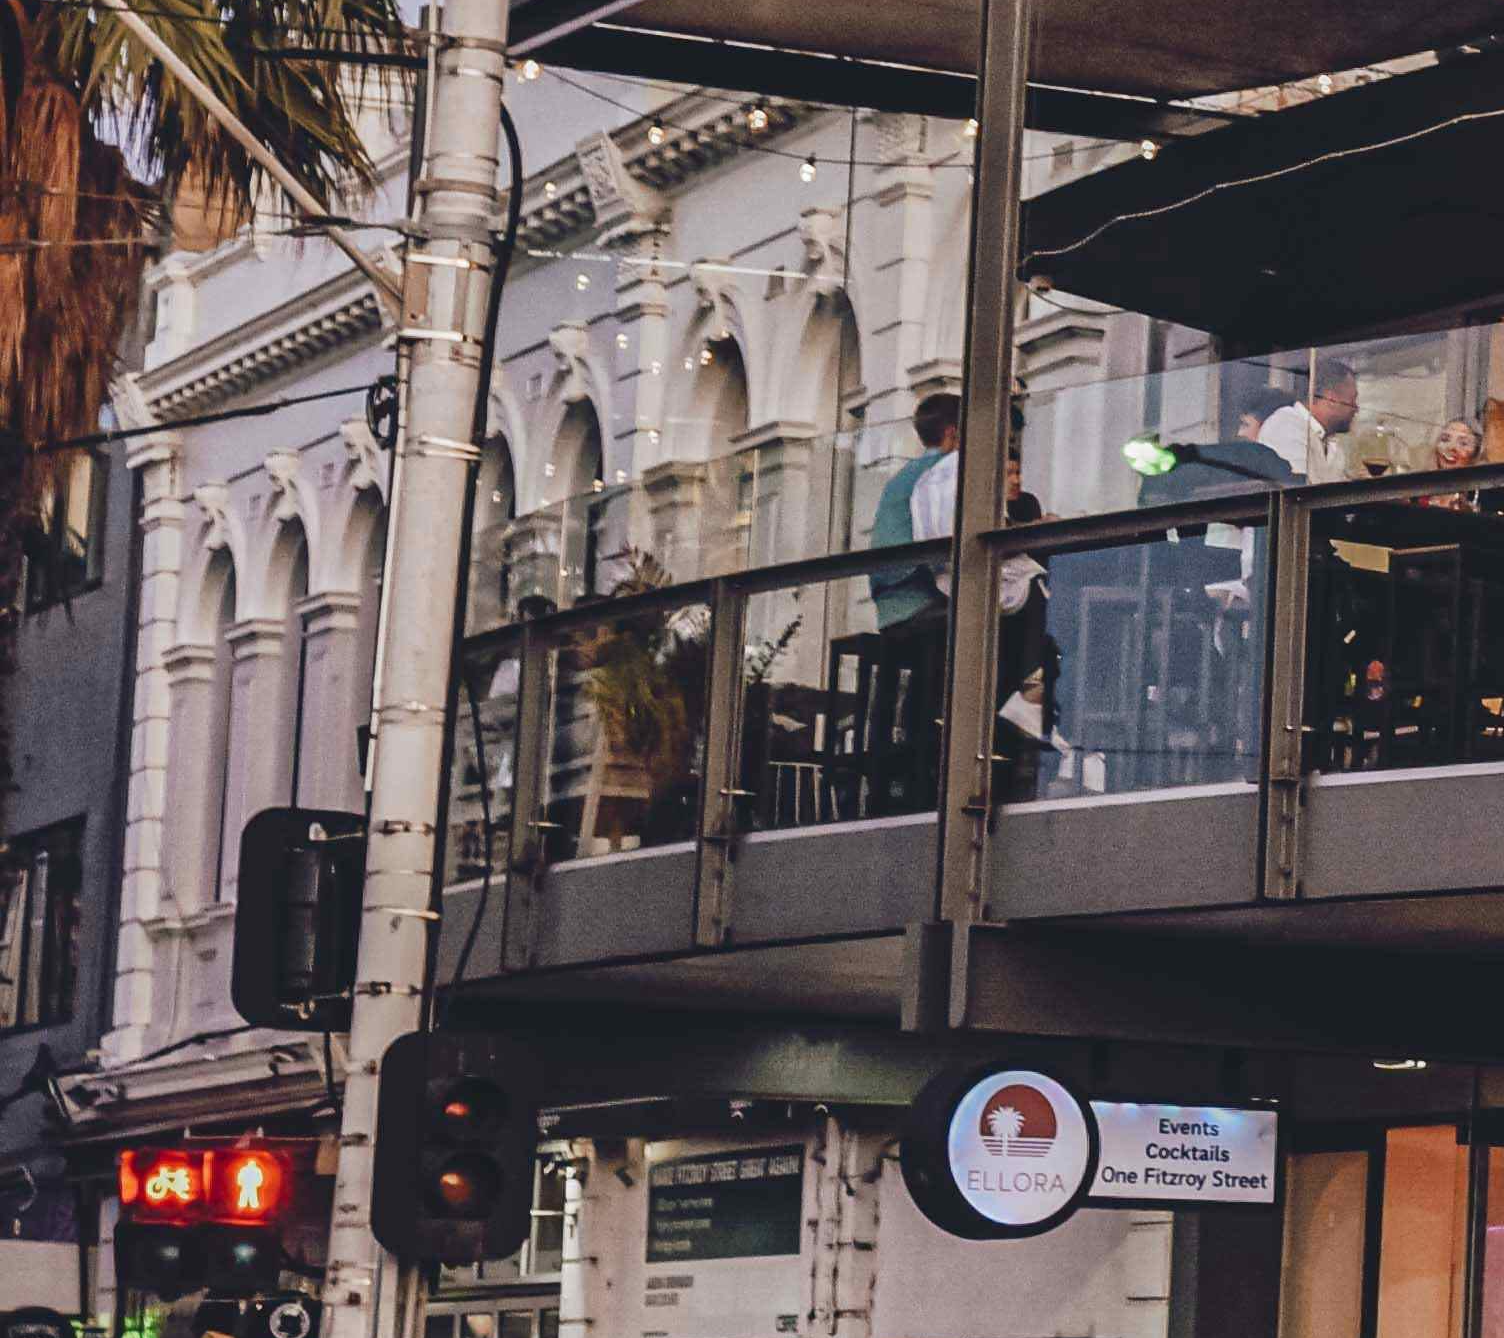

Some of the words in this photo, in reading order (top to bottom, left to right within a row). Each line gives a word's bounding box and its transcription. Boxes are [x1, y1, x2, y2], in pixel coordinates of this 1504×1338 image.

[1160, 1119, 1220, 1136] Events
[1146, 1143, 1231, 1163] Cocktails
[967, 1169, 1067, 1193] ELLORA
[1101, 1166, 1138, 1185] One
[1145, 1167, 1206, 1191] Fitzroy
[1212, 1170, 1268, 1190] Street
